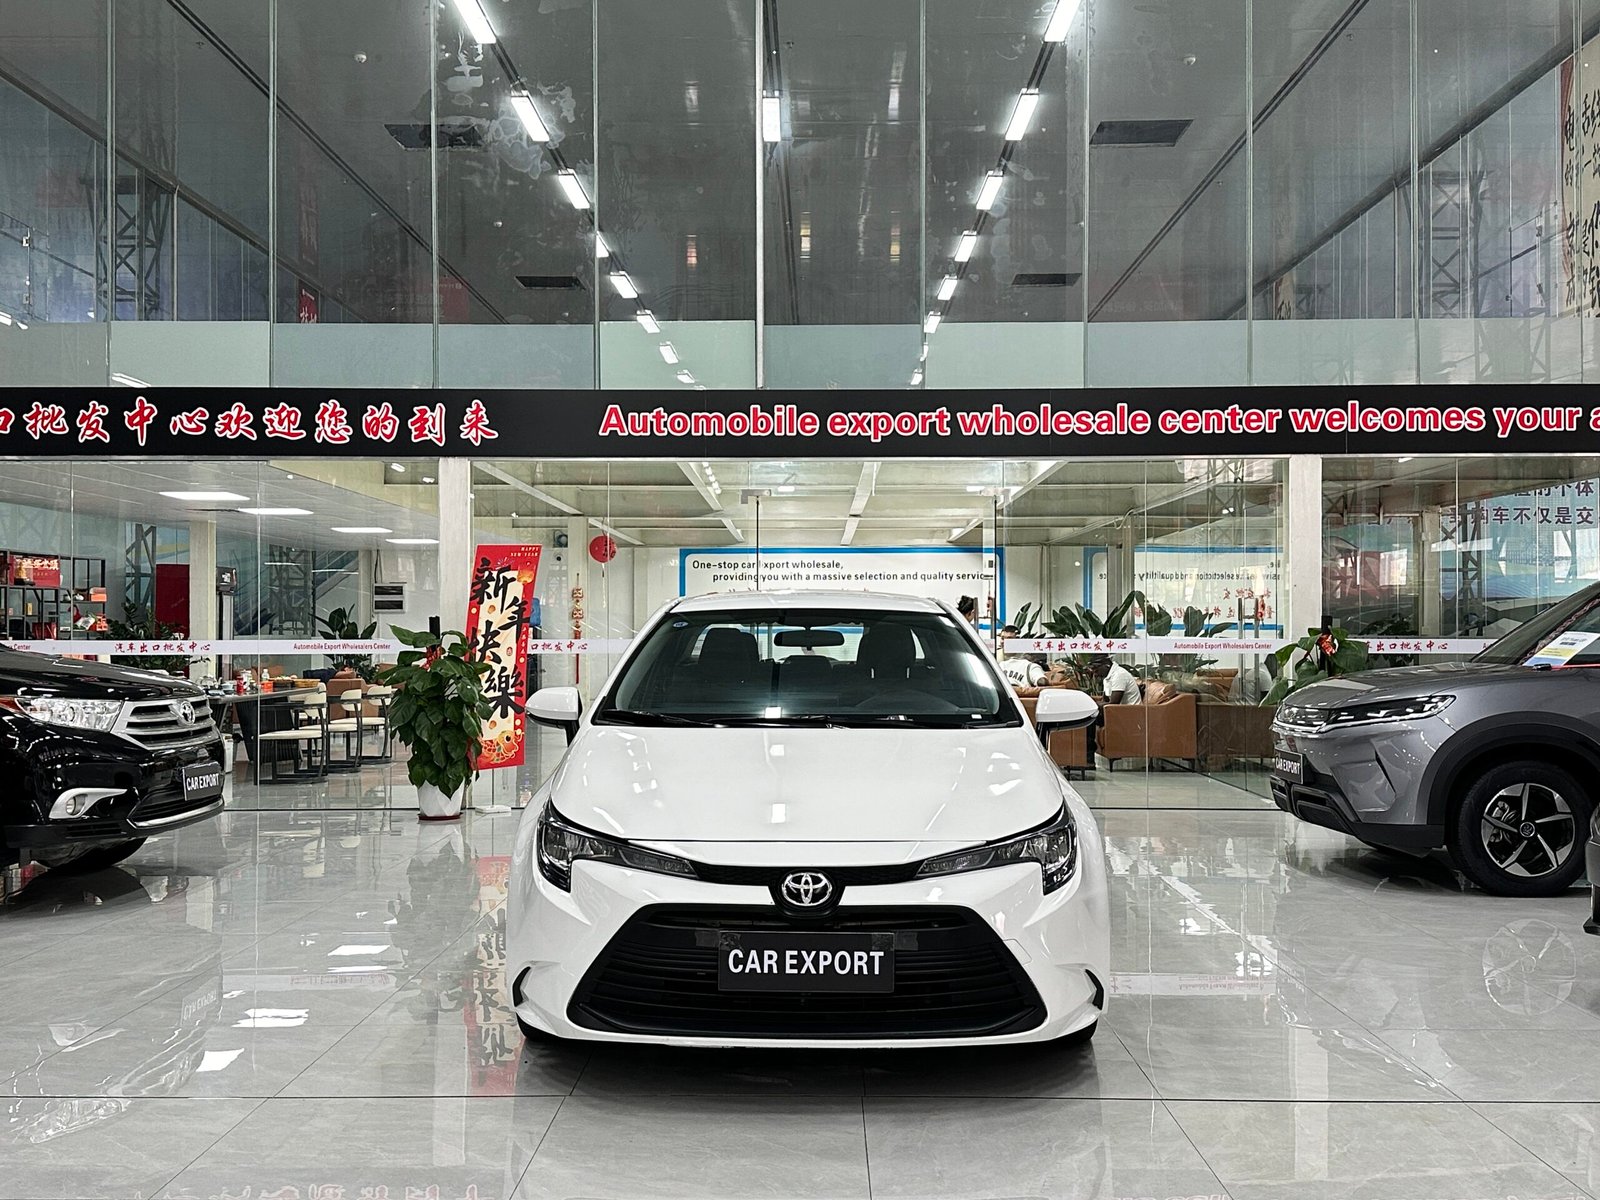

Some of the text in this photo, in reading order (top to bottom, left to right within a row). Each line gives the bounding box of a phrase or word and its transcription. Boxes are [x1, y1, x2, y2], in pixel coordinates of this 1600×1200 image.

[598, 404, 821, 437] Automobile
[826, 406, 952, 443] export
[955, 402, 1152, 436] wholesale
[1157, 403, 1283, 435] center
[1287, 399, 1487, 433] welcomes
[1492, 406, 1583, 439] your
[692, 560, 739, 571] One-stop
[741, 561, 757, 570] car
[791, 560, 843, 571] wholesale,
[712, 572, 759, 583] providing
[762, 574, 779, 583] you
[781, 572, 803, 581] with
[813, 573, 852, 581] massive
[854, 571, 897, 581] selection
[900, 571, 918, 581] and
[920, 571, 954, 582] quality
[114, 640, 211, 653] 汽车出口批发中心
[293, 642, 391, 652] Automobile Export Wholesalers Center
[530, 641, 588, 653] 口批发中心
[1033, 640, 1128, 652] 汽车出口批发中心
[1174, 642, 1272, 651] Automobile Export Wholesalers Center
[1275, 756, 1301, 775] CAR EXPORT
[186, 773, 220, 791] CAR EXPORT
[728, 948, 885, 975] CAR EXPORT
